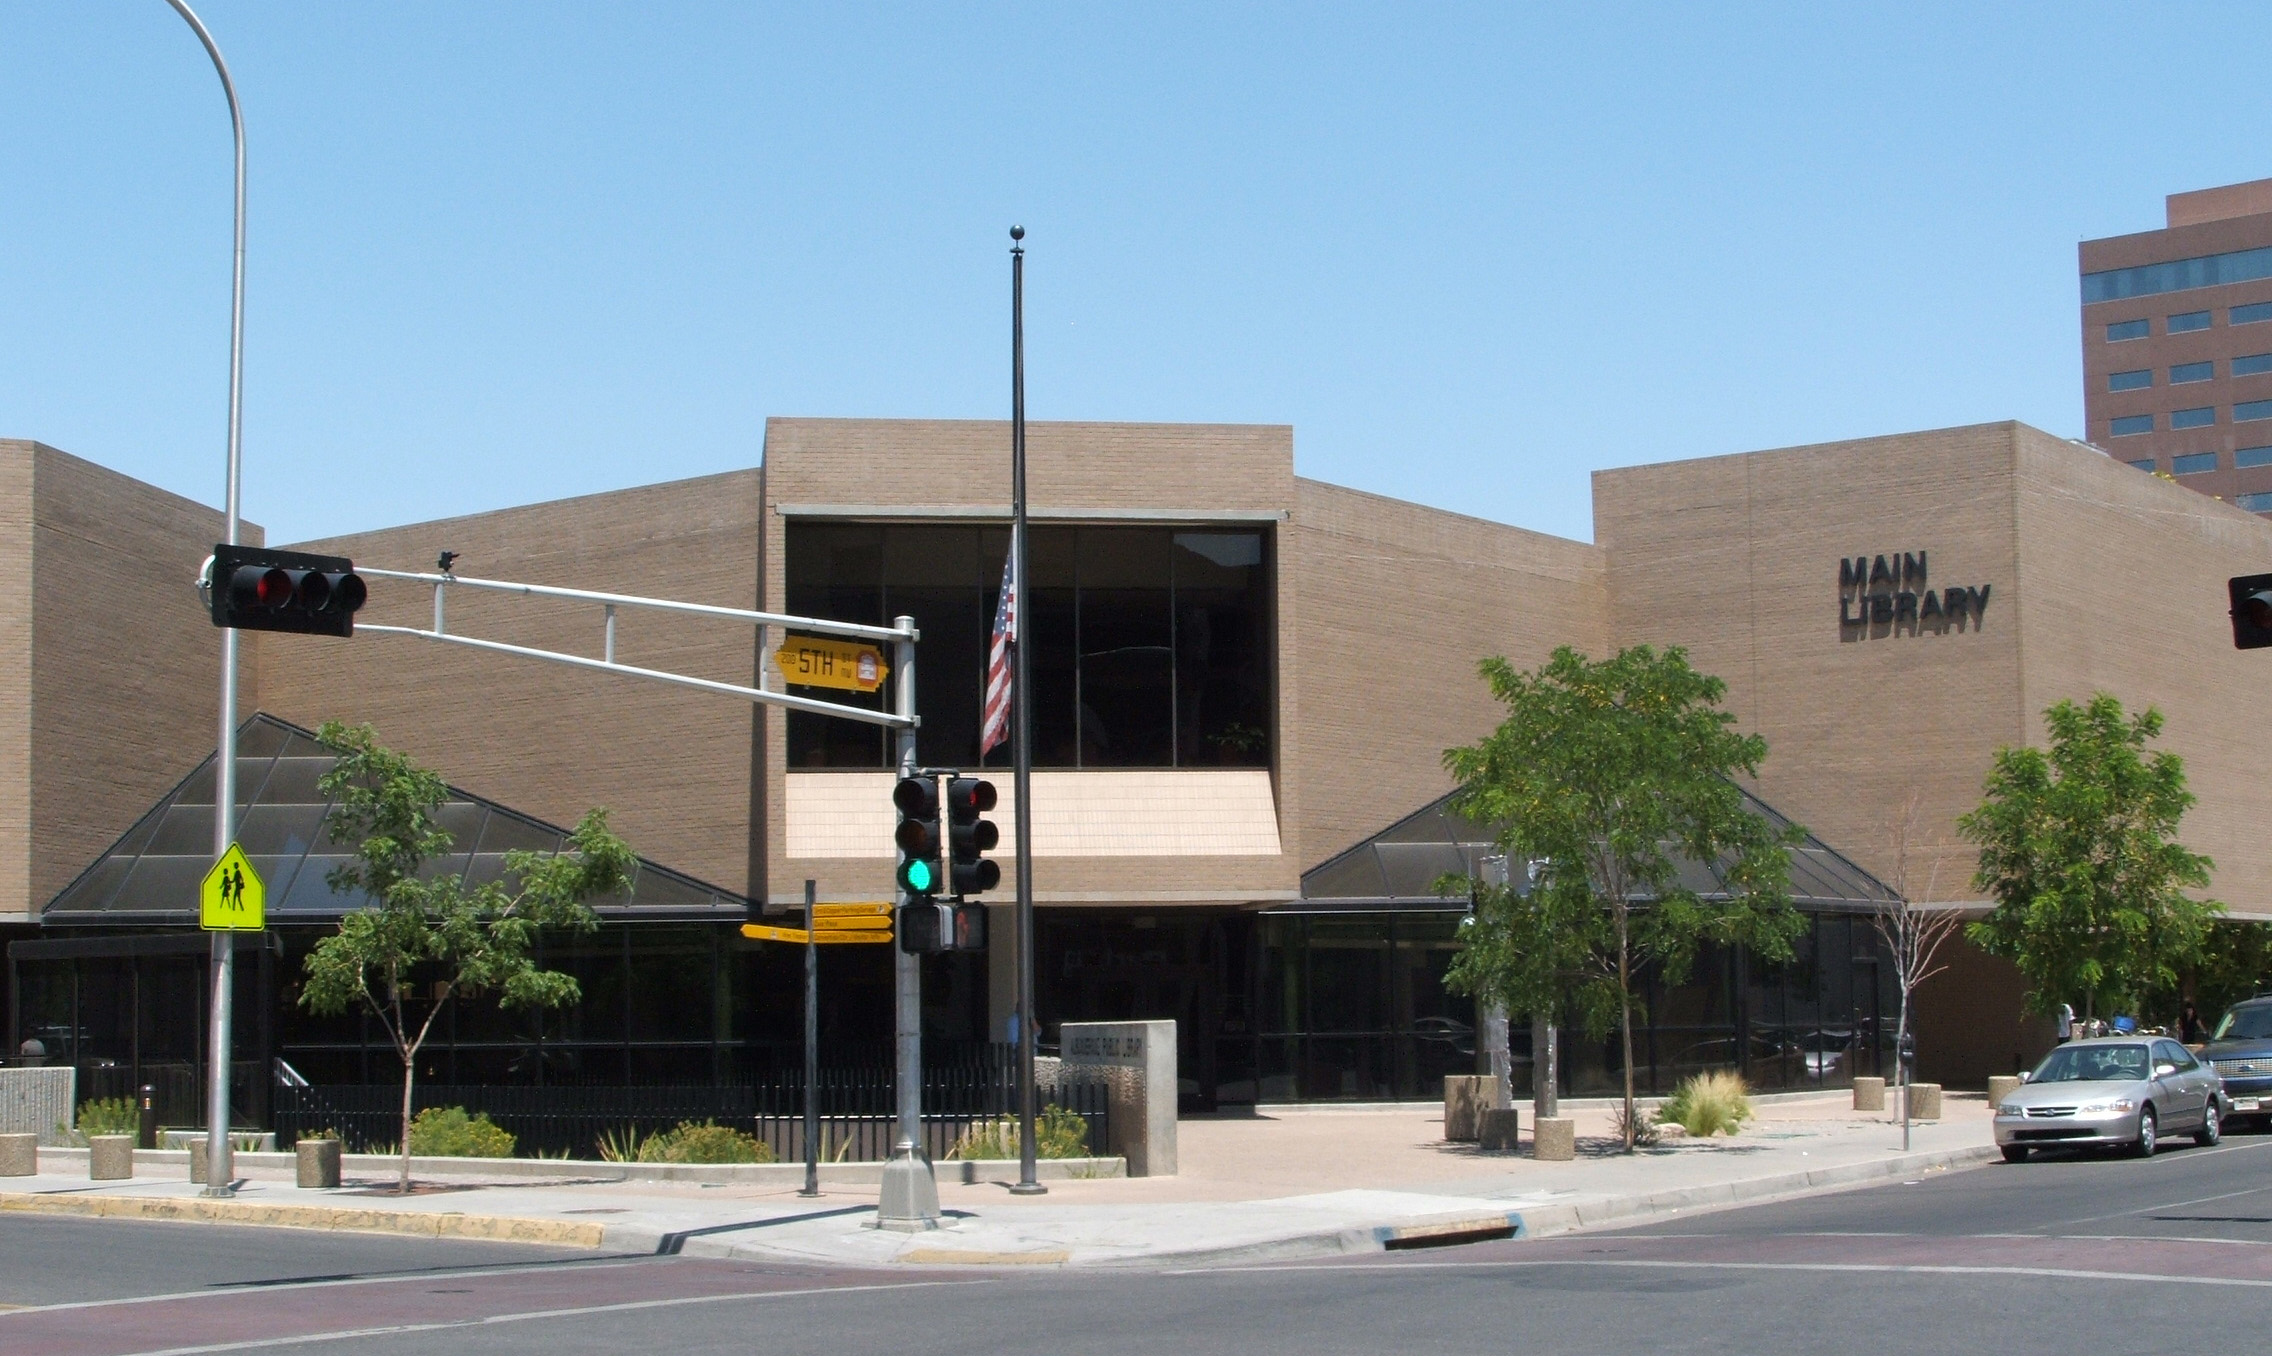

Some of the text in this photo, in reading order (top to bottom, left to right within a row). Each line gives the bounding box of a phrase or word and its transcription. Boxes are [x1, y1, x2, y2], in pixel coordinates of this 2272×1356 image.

[1839, 551, 1926, 587] MAIN
[1840, 584, 1992, 627] LIBRARY
[799, 649, 833, 675] 5TH
